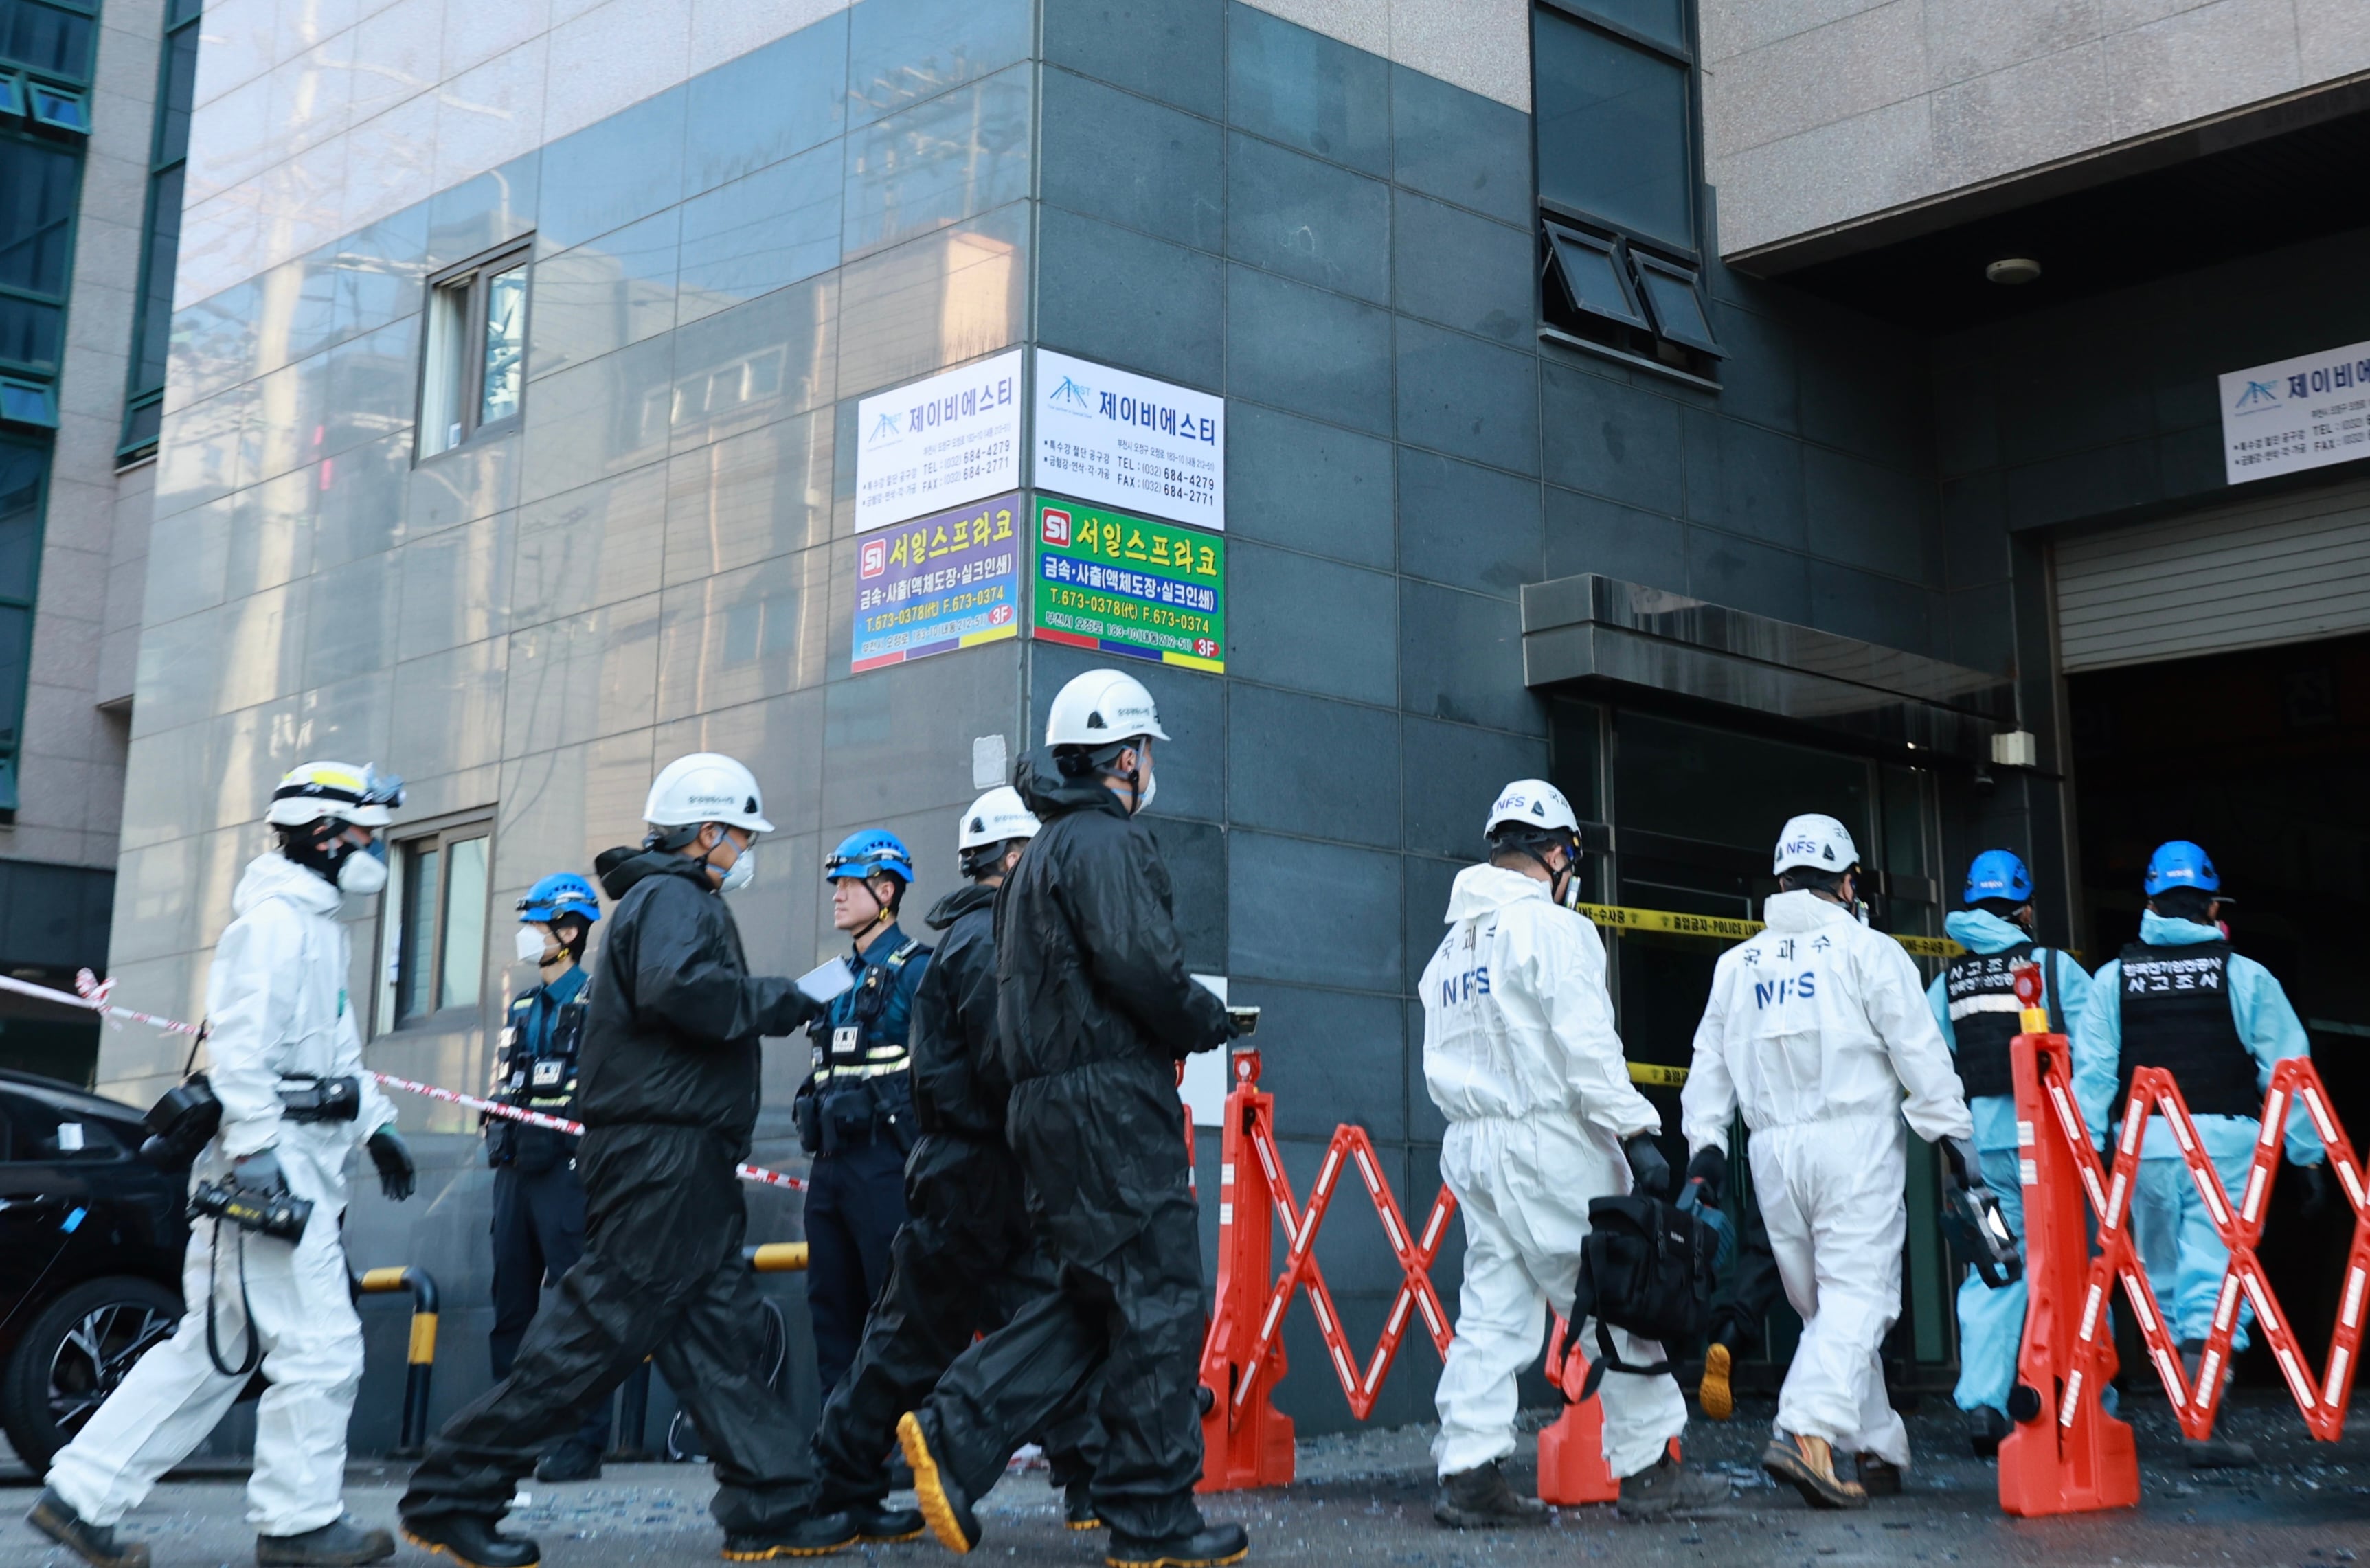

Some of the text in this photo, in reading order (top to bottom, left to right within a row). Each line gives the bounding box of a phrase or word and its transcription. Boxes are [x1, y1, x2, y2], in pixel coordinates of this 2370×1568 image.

[909, 377, 1012, 432] 제이비에스티
[1099, 391, 1215, 446] 제이비에스티
[964, 439, 1010, 464] 684-4279
[1090, 449, 1110, 464] 공구강
[963, 456, 1008, 480] 684-2771
[1142, 463, 1161, 477] (032)
[1164, 468, 1214, 490] 684-4279
[1142, 479, 1161, 493] (032)
[1164, 484, 1213, 506] 684-2771
[889, 509, 1013, 568] 서일스프라코
[1076, 517, 1217, 576] 서일스프라코
[943, 585, 1004, 613] F.673-0374
[993, 606, 1008, 624] 3F
[1142, 606, 1209, 634] F.673-0374
[1198, 639, 1215, 657] 3F
[1497, 796, 1525, 811] NFS
[1787, 841, 1816, 854] NFS
[1443, 966, 1490, 1008] NFS
[1755, 971, 1814, 1010] NFS
[2128, 971, 2220, 994] 사고조사
